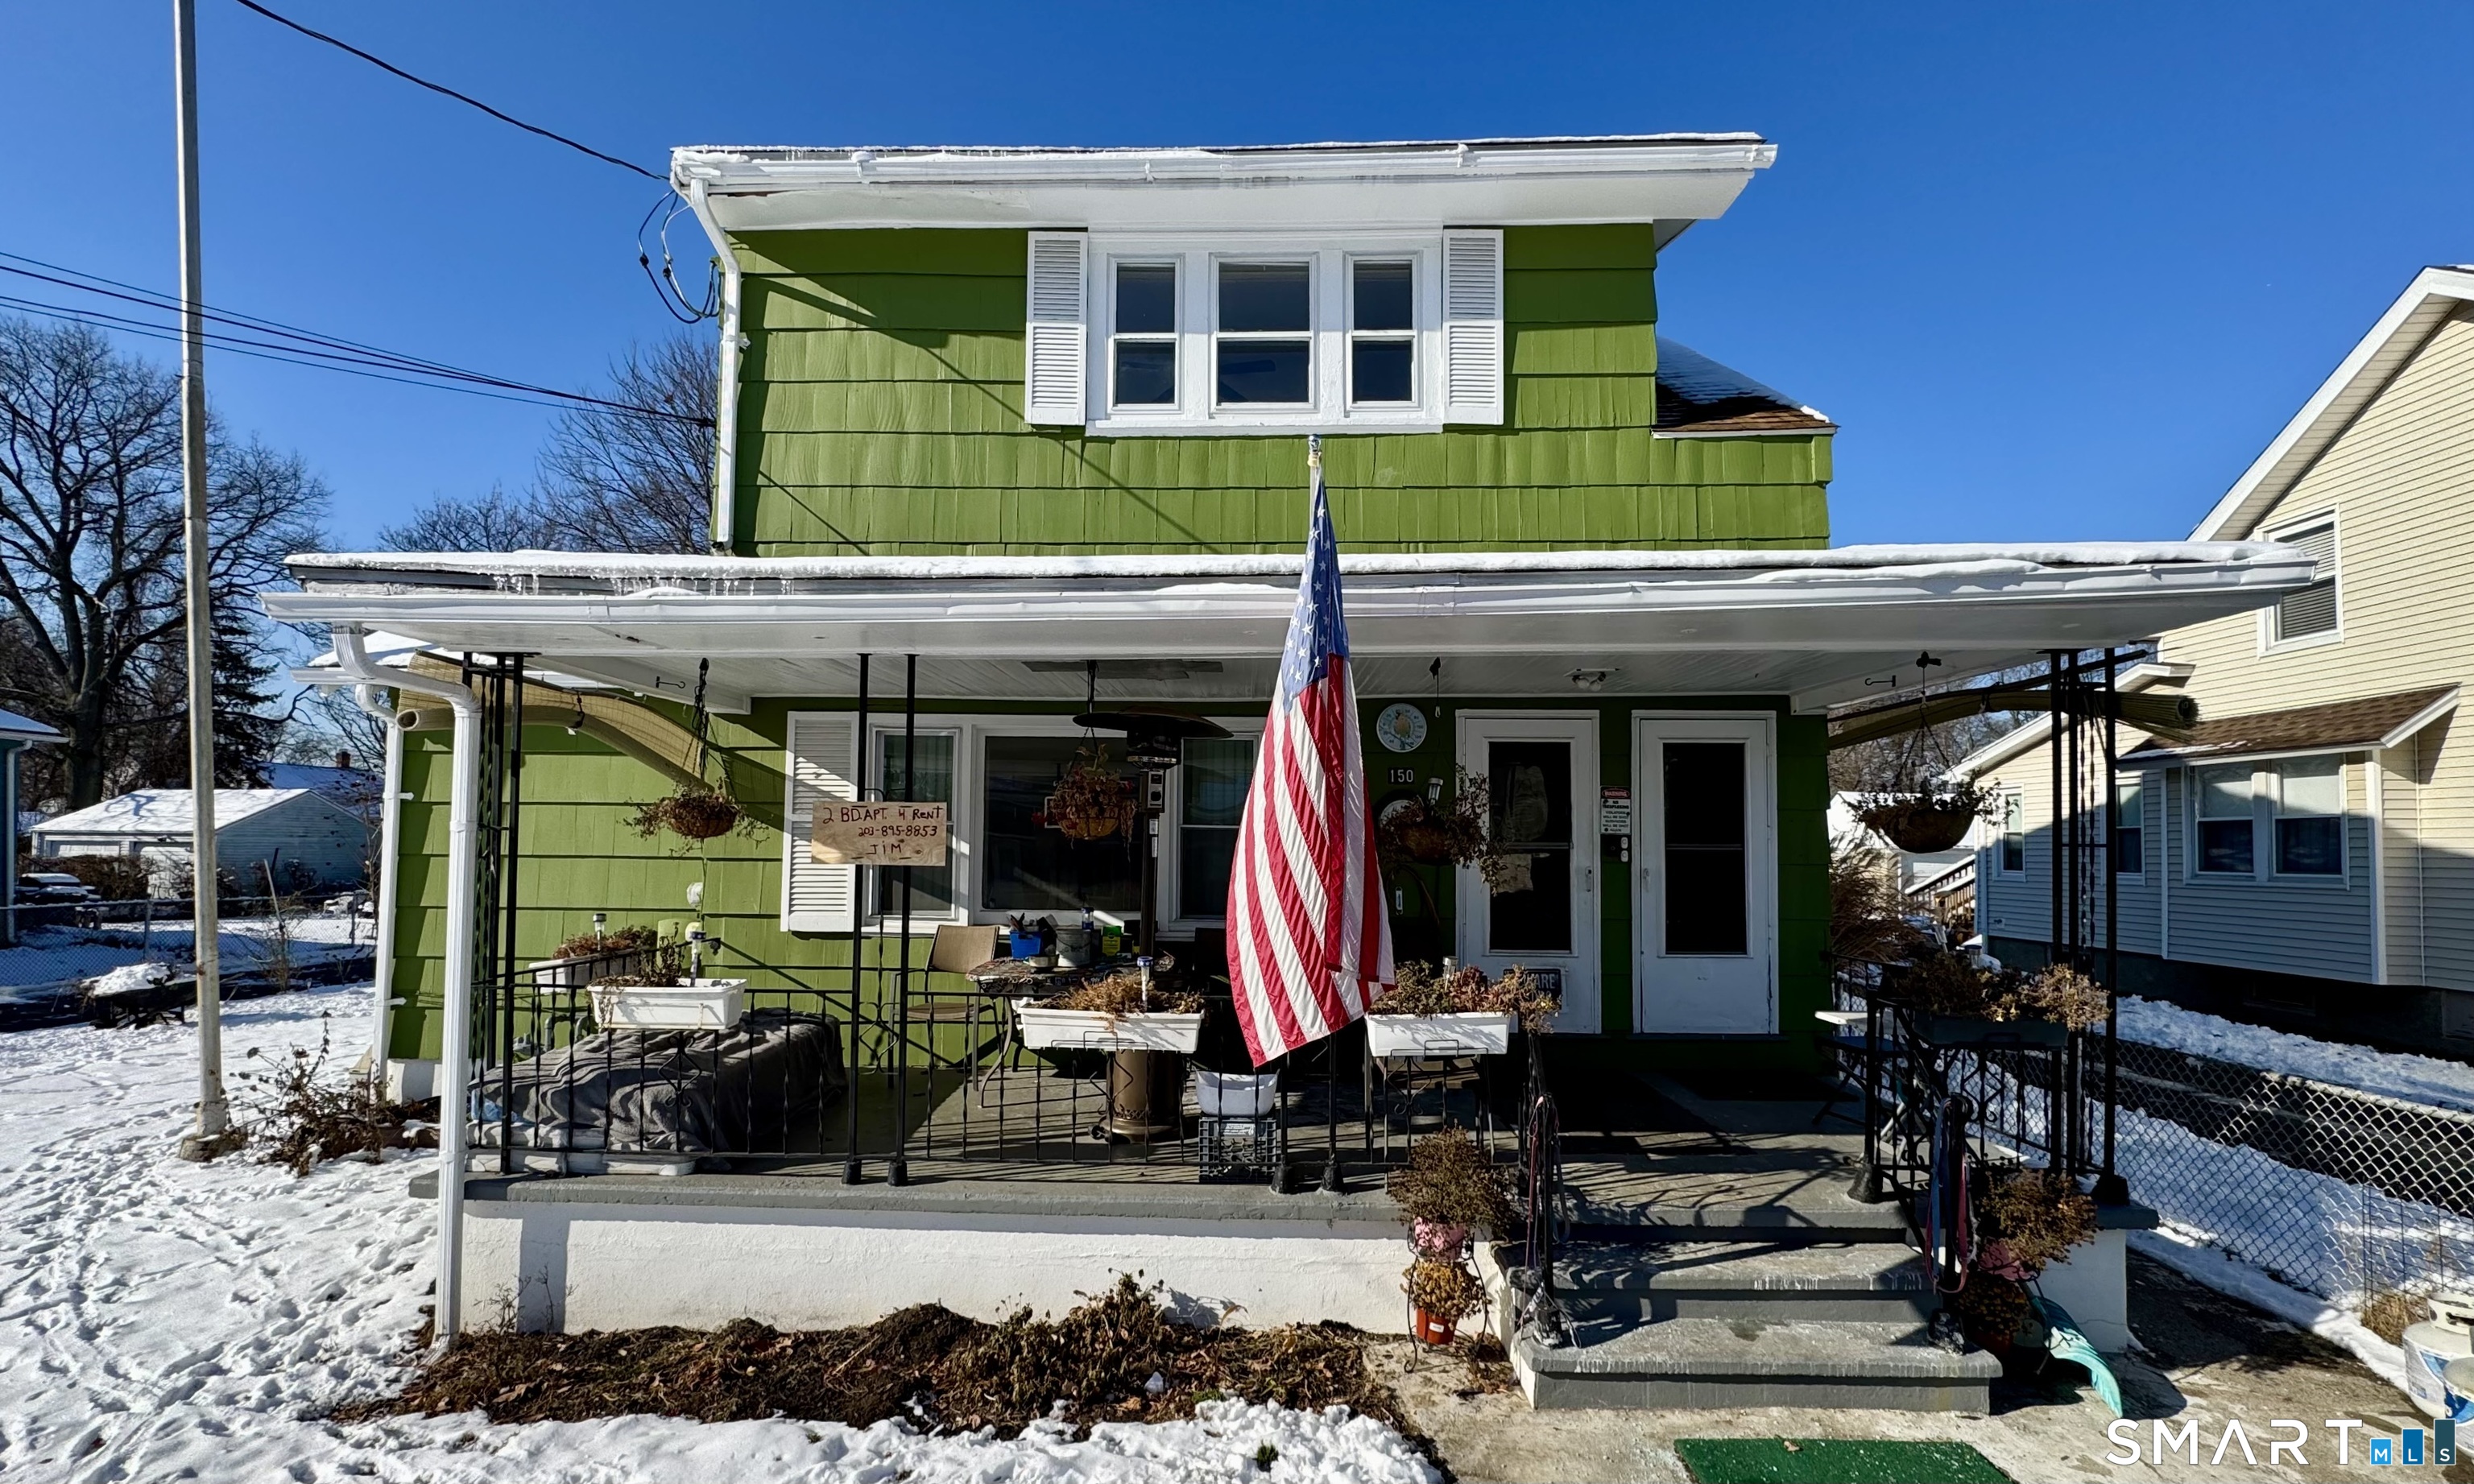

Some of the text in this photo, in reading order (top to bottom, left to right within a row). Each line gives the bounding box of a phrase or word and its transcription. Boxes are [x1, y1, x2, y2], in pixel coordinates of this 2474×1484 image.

[1390, 769, 1413, 783] 150
[822, 807, 834, 824] 2
[899, 808, 905, 820] 4
[858, 825, 937, 837] 203-895-8853
